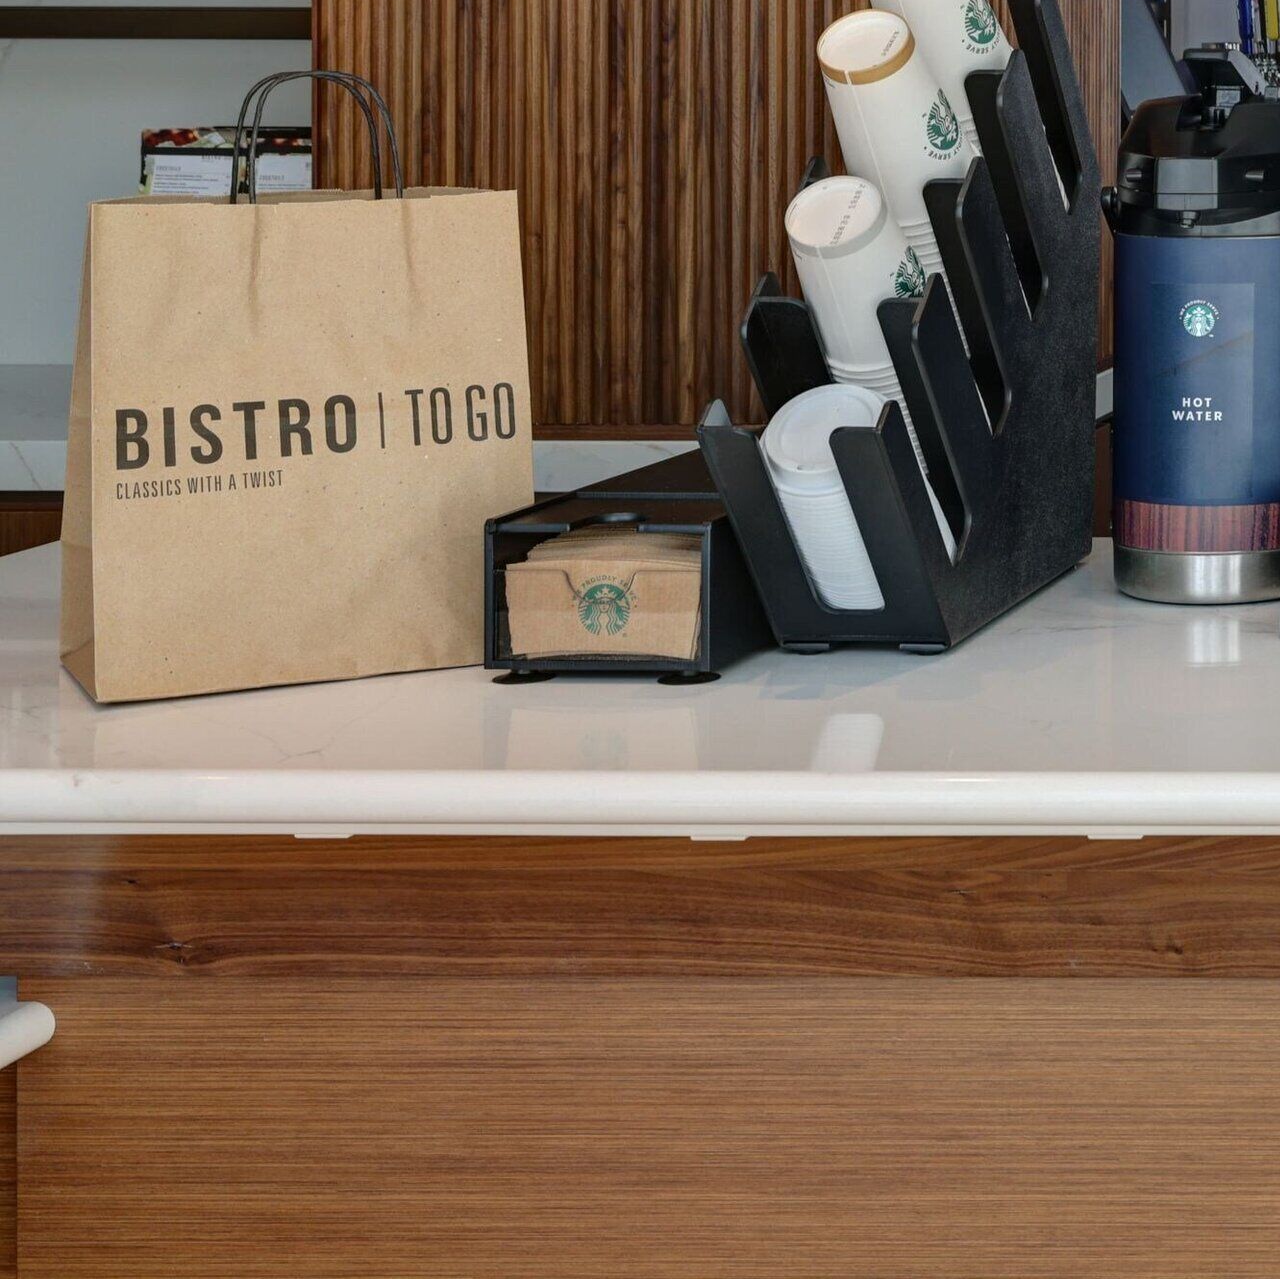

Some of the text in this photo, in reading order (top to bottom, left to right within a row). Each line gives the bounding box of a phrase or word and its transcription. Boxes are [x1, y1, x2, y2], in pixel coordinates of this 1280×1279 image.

[1182, 397, 1212, 408] HOT
[115, 382, 516, 470] BISTRO TO GO
[1172, 410, 1222, 422] WATER
[116, 470, 284, 500] CLASSICS WITH A TWIST
